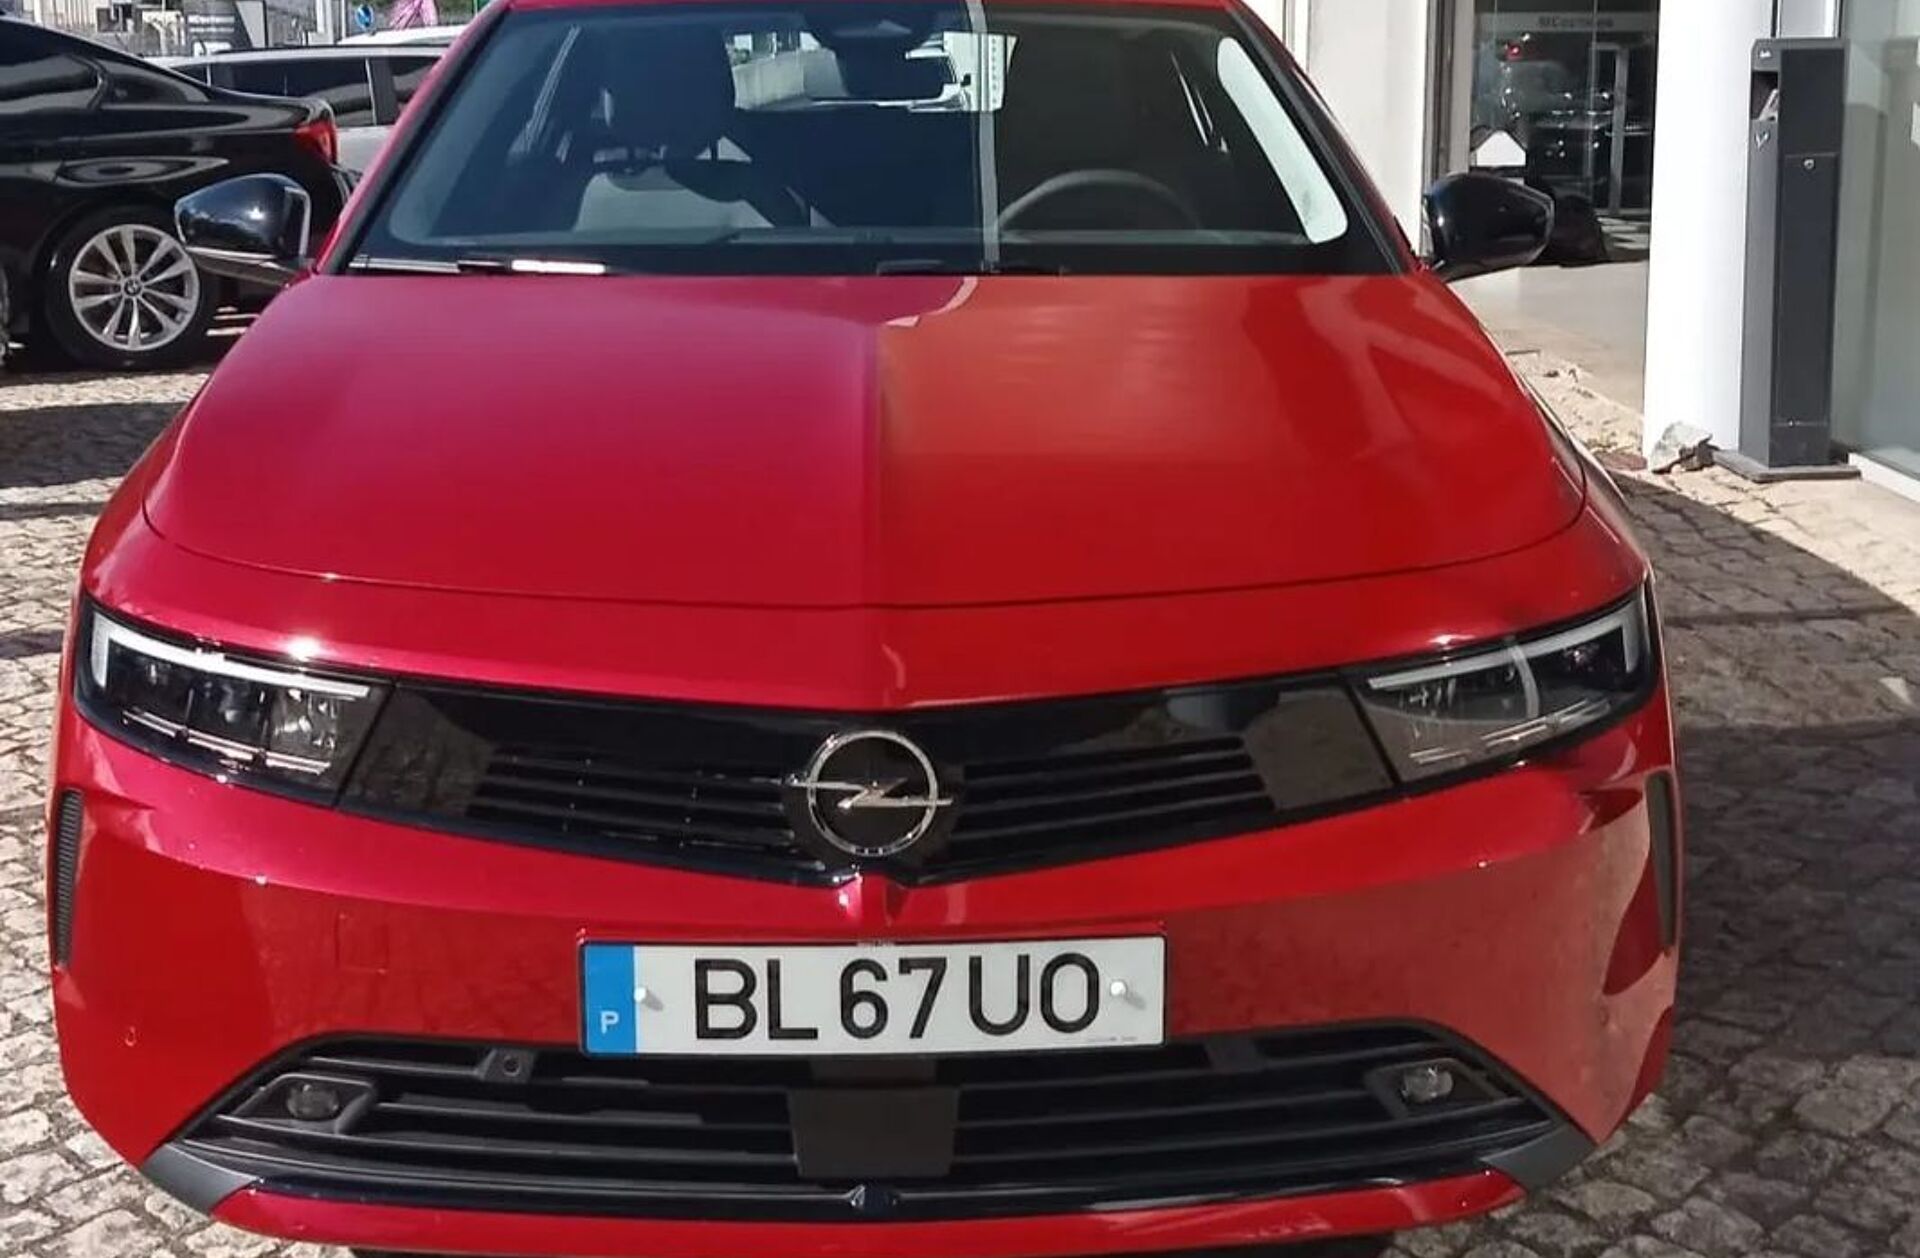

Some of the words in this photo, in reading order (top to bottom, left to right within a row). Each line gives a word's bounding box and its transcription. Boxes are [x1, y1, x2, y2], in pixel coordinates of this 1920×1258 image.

[600, 1010, 620, 1034] P
[694, 957, 819, 1041] BL
[838, 955, 948, 1040] 67
[968, 952, 1100, 1037] UO
